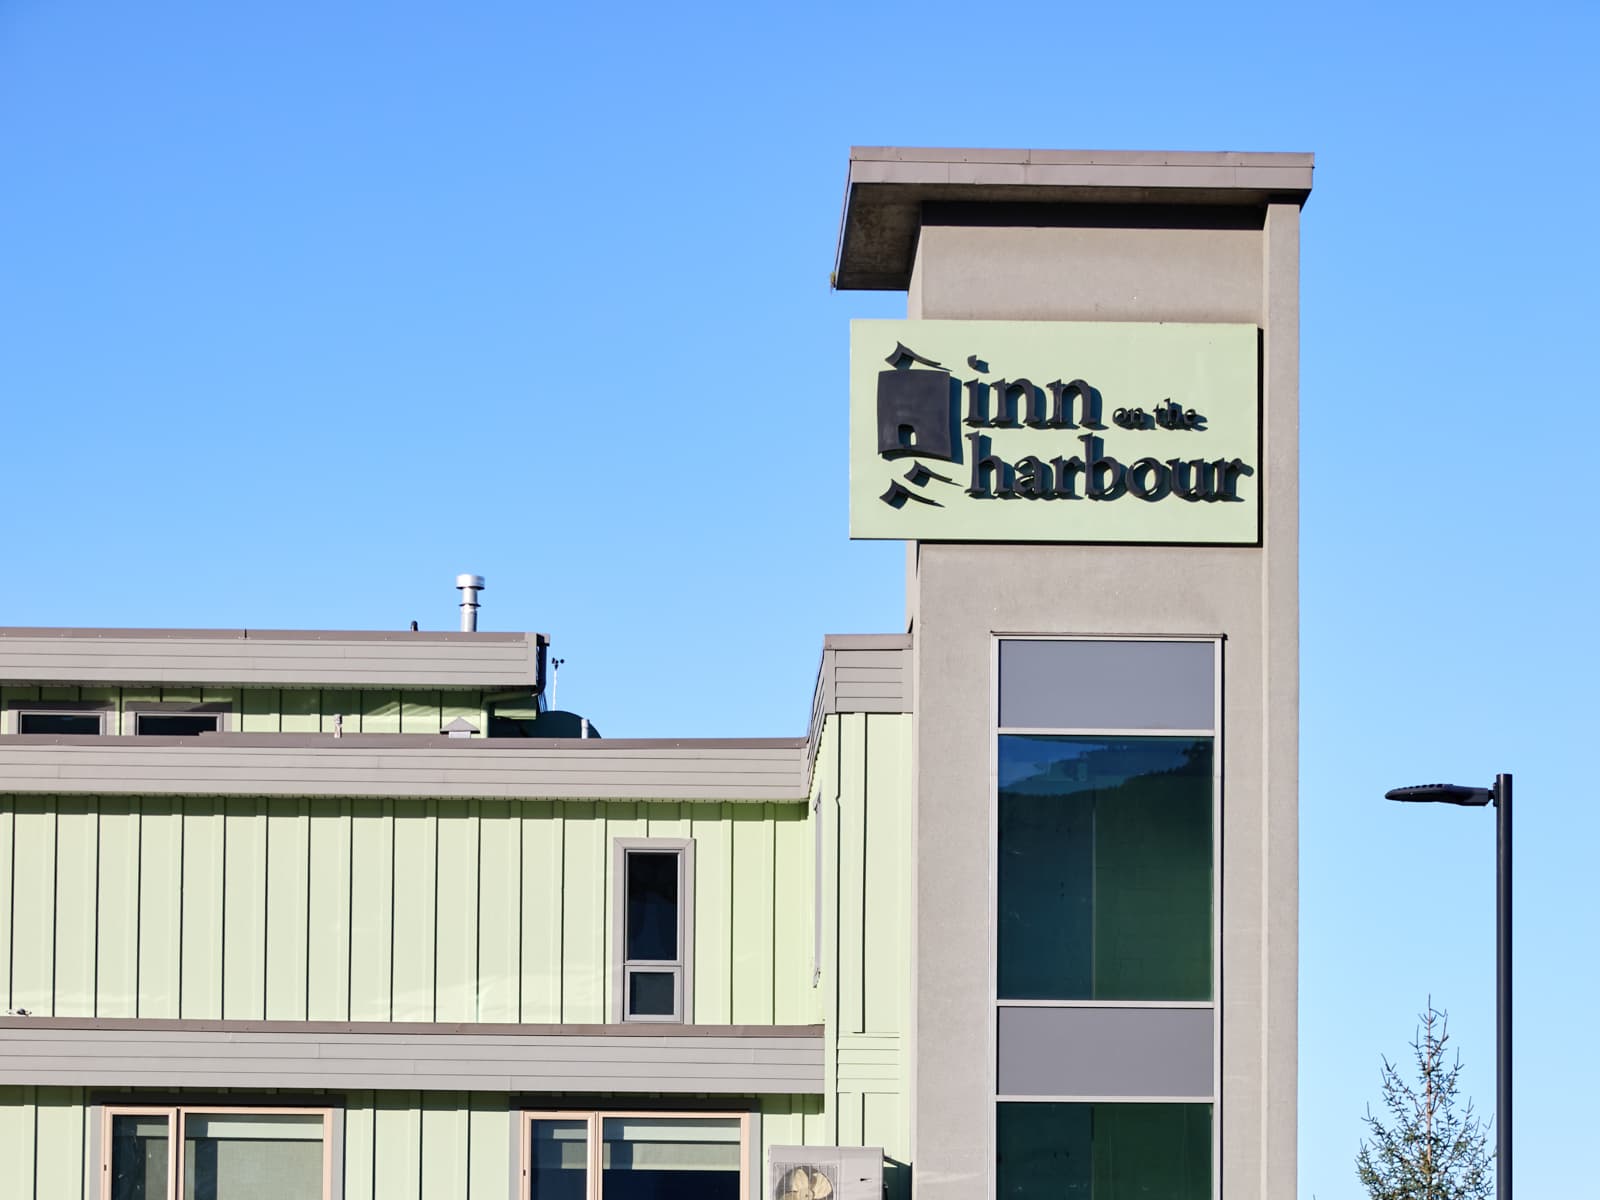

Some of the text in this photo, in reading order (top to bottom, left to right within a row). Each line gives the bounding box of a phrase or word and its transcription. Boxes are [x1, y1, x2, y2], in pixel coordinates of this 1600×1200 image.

[963, 354, 1203, 431] inn on the
[964, 431, 1255, 502] harbour
